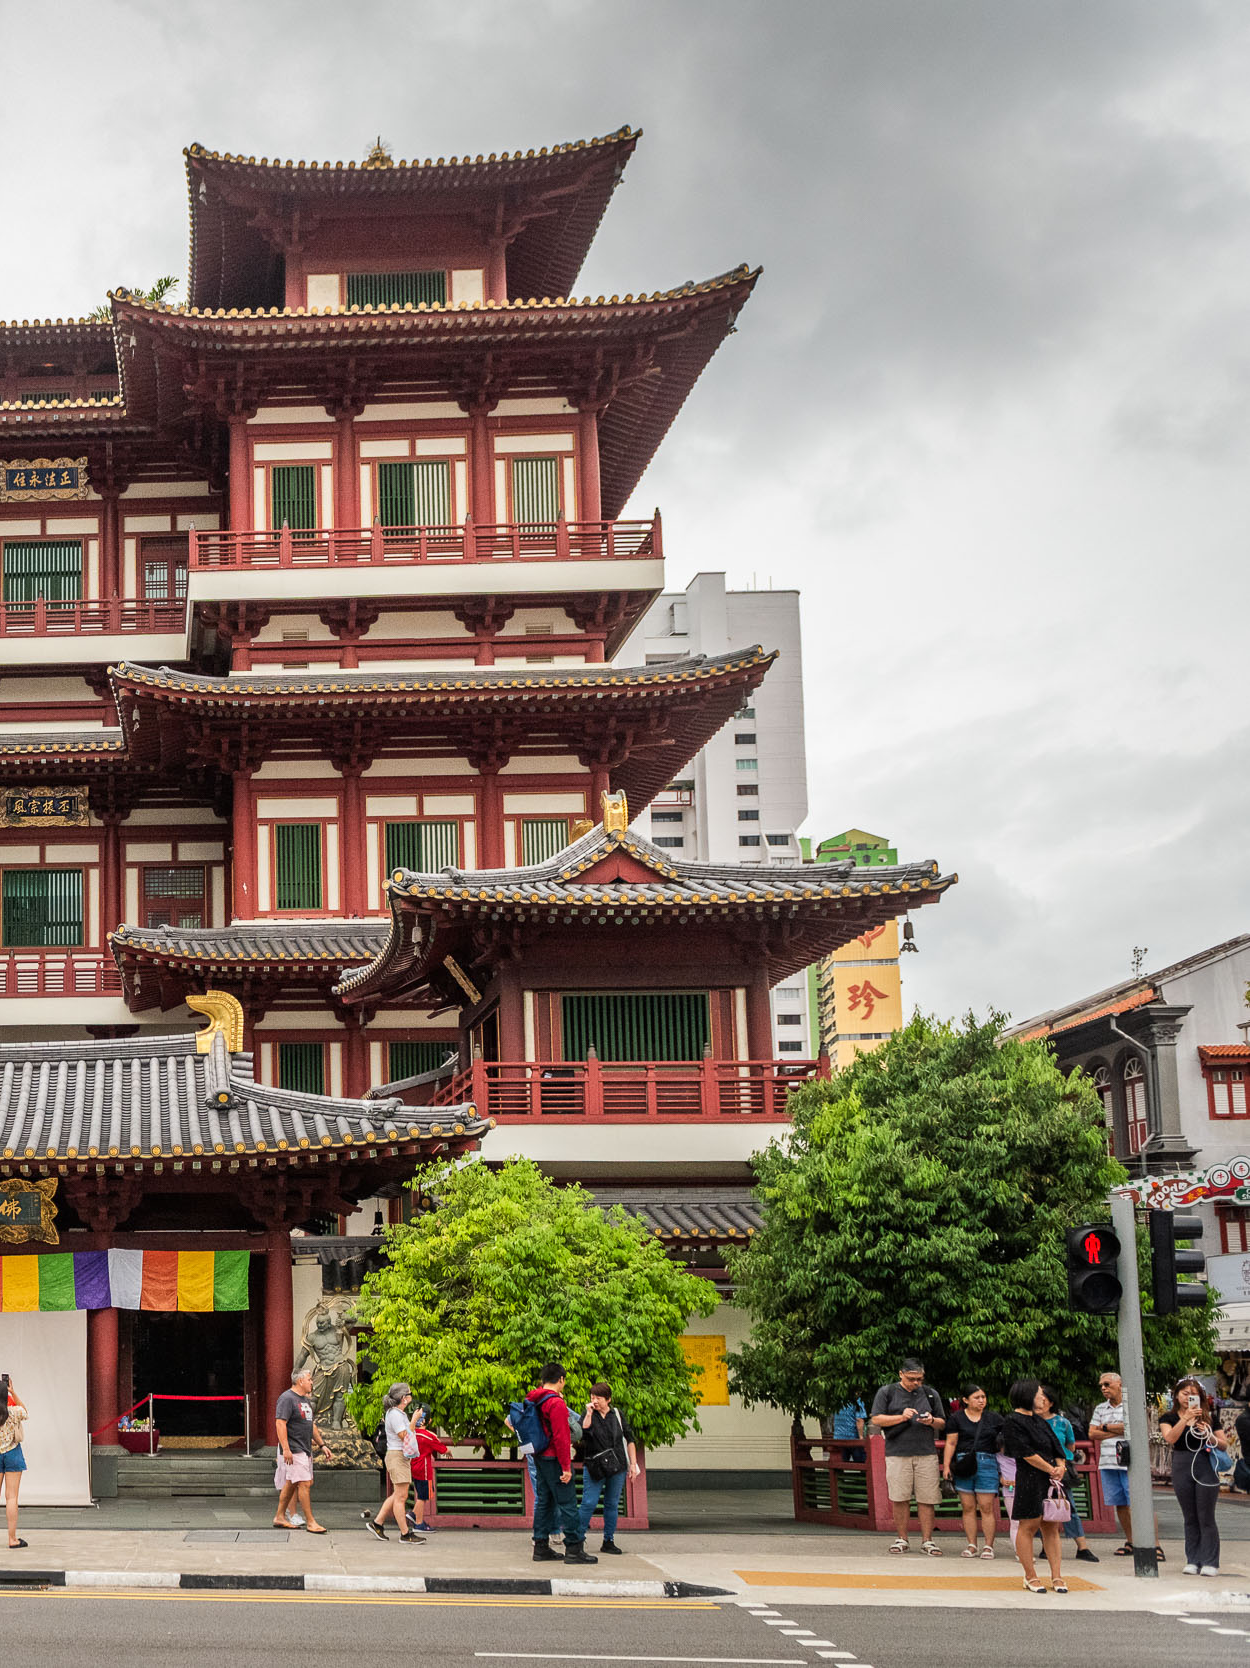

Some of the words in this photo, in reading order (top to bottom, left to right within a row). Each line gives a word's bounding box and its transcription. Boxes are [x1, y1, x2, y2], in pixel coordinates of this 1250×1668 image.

[13, 471, 71, 488] 正法永住
[847, 980, 890, 1020] 珍
